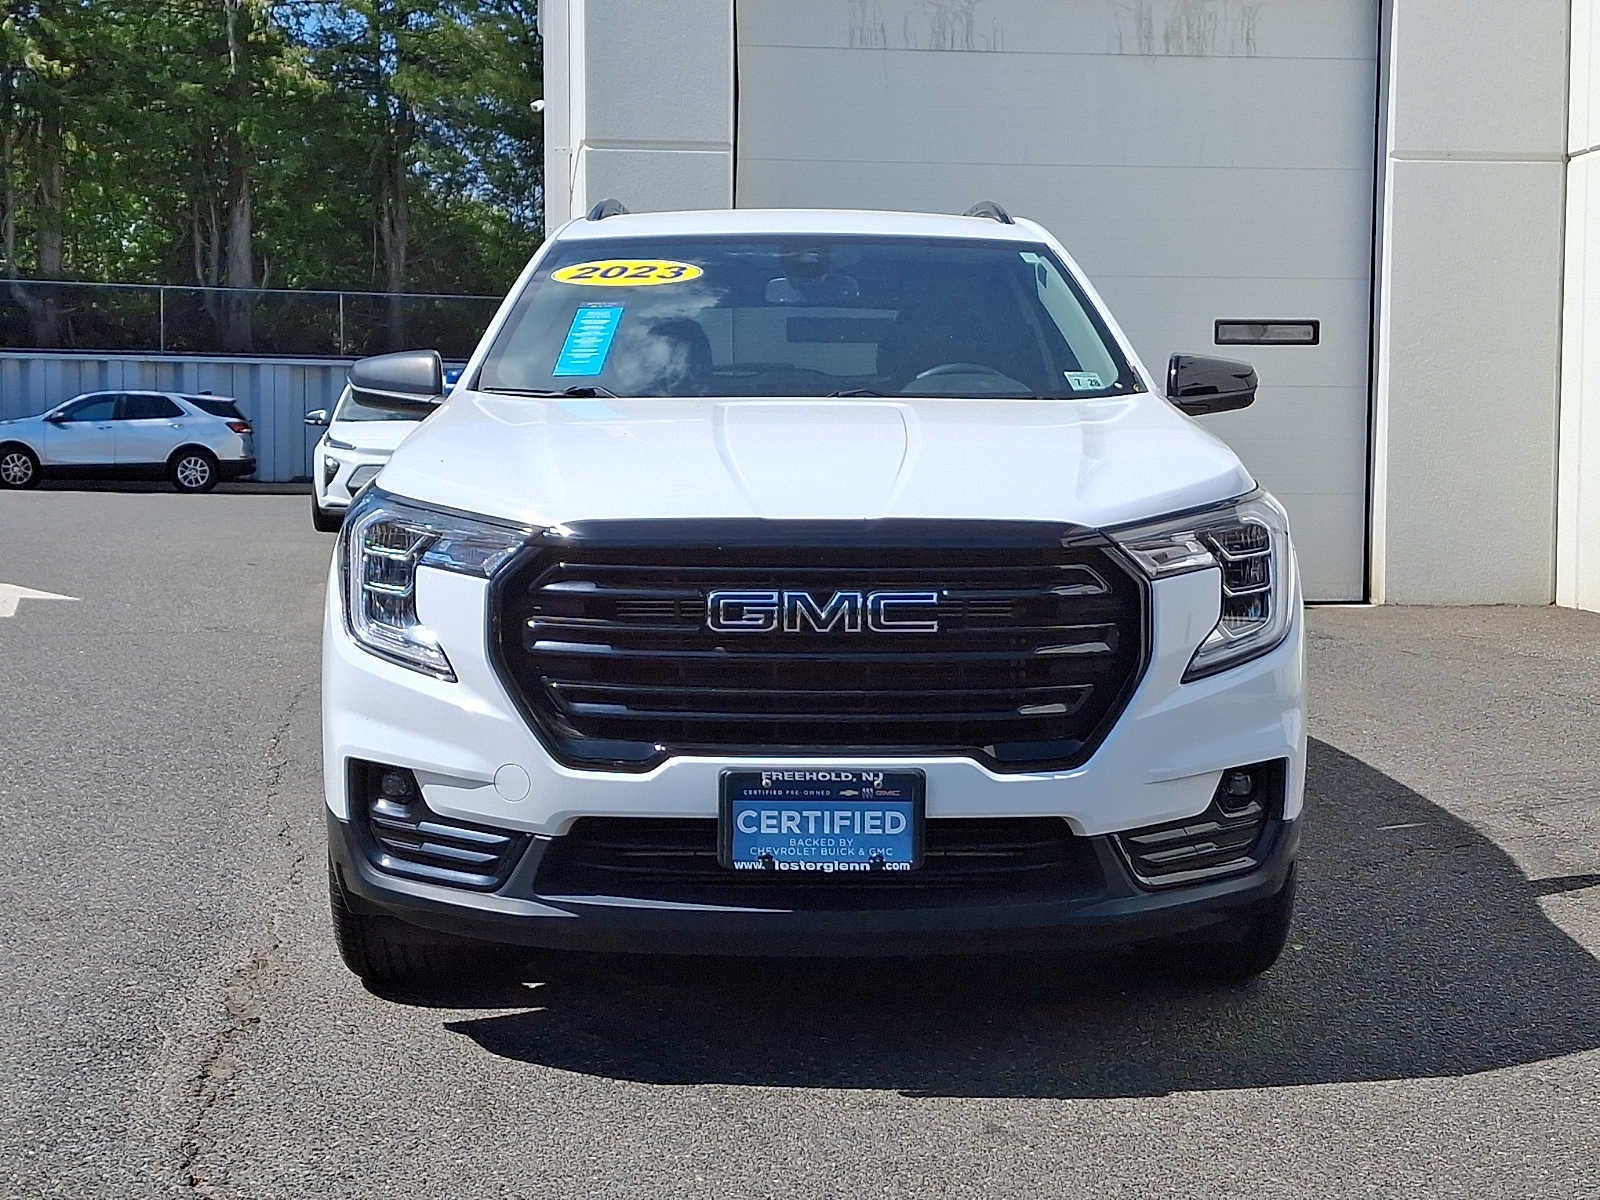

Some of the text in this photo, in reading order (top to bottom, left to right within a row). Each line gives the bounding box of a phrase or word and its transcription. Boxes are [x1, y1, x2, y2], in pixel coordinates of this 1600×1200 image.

[568, 265, 687, 280] 2023
[706, 590, 938, 632] GMC
[761, 771, 884, 784] FREEHOLD, NJ
[743, 788, 783, 797] CERTIFIED
[875, 789, 902, 797] GMC
[736, 810, 907, 835] CERTIFIED
[789, 838, 854, 847] BACKED BY
[750, 847, 894, 856] CHEVROLET BUICK & GMC
